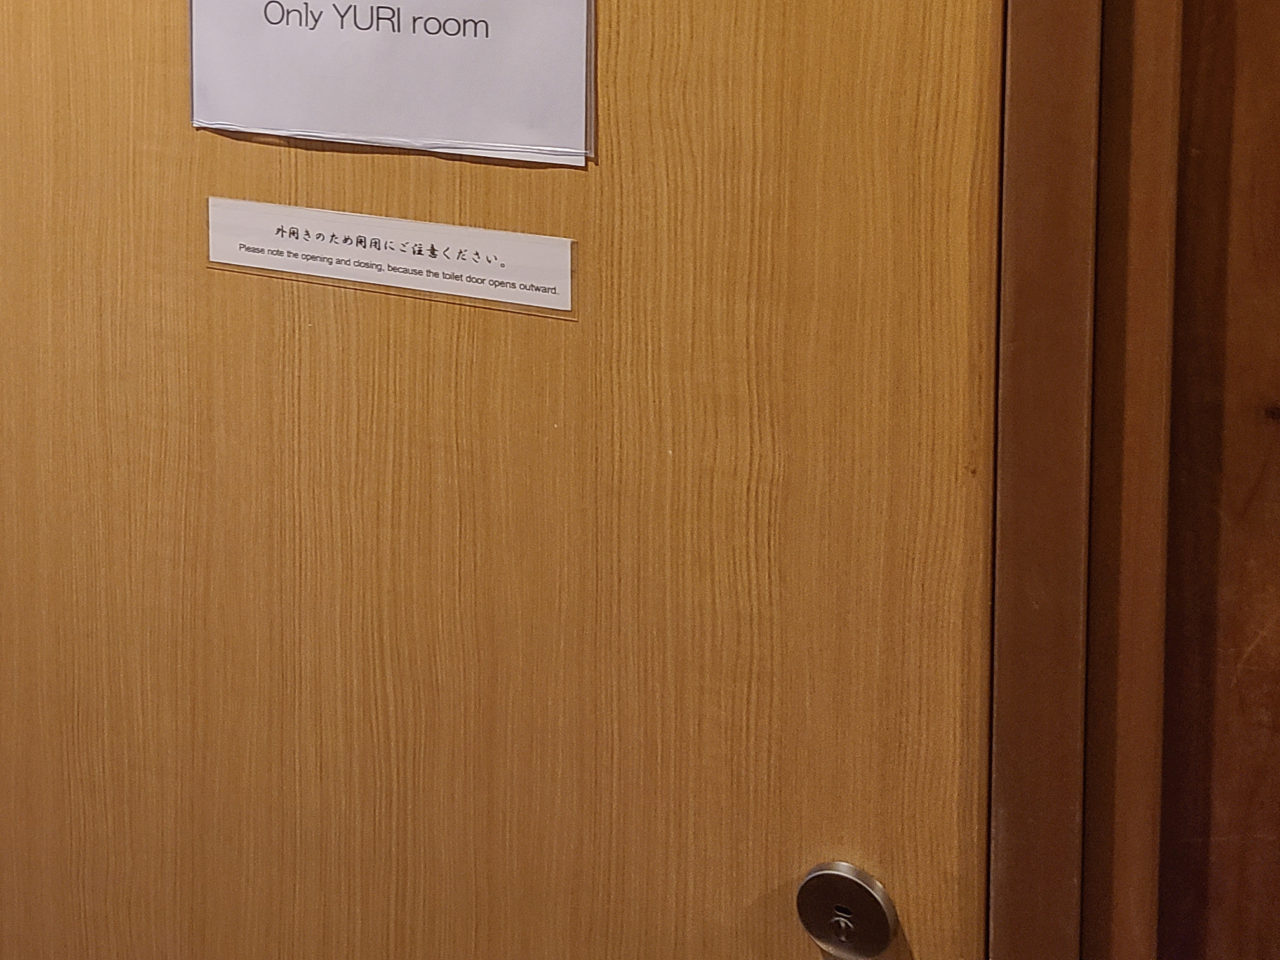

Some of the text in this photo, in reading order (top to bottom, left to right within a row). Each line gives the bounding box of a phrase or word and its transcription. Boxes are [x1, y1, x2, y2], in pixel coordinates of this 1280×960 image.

[264, 0, 490, 39] Only YURI room
[238, 243, 265, 255] Please
[267, 248, 285, 257] note
[286, 250, 299, 259] the
[301, 253, 333, 266] opening
[335, 257, 351, 267] and
[353, 259, 385, 272] closing,
[387, 263, 424, 277] because
[426, 269, 440, 279] the
[442, 271, 464, 282] toilet
[465, 274, 486, 285] door
[488, 279, 517, 290] opens
